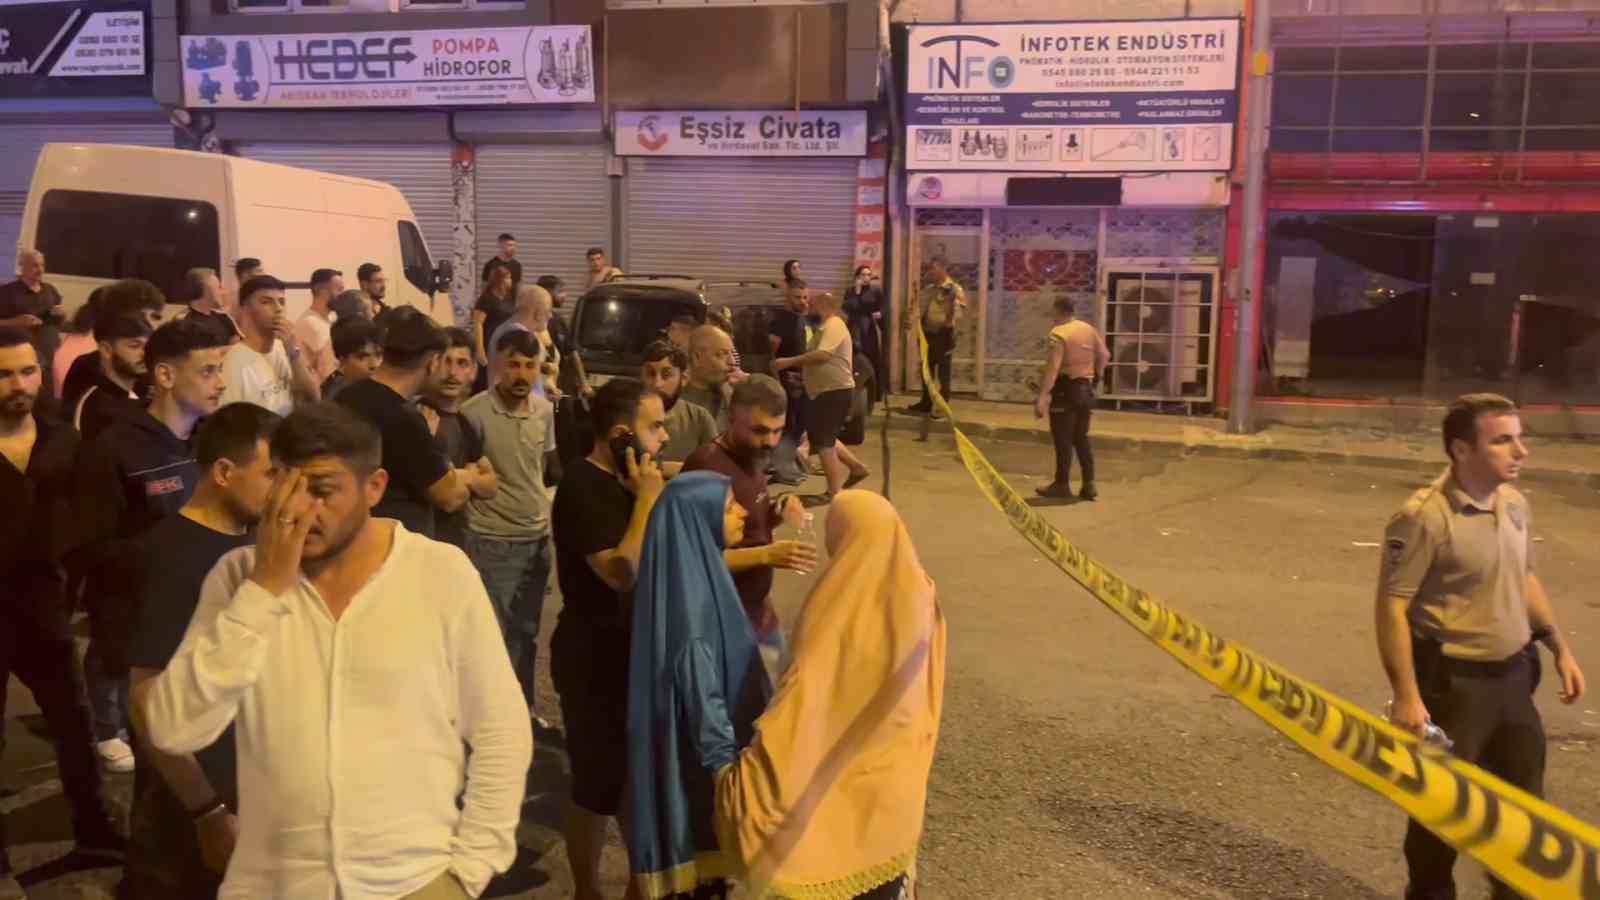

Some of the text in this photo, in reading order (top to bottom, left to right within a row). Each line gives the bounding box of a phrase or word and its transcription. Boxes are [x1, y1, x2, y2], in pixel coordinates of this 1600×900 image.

[432, 38, 499, 55] POMPA
[1020, 30, 1225, 52] İNFOTEK ENDÜSTRİ
[423, 57, 512, 77] HİDROFOR
[1151, 67, 1169, 75] 221
[680, 115, 841, 144] Eşsiz Civata
